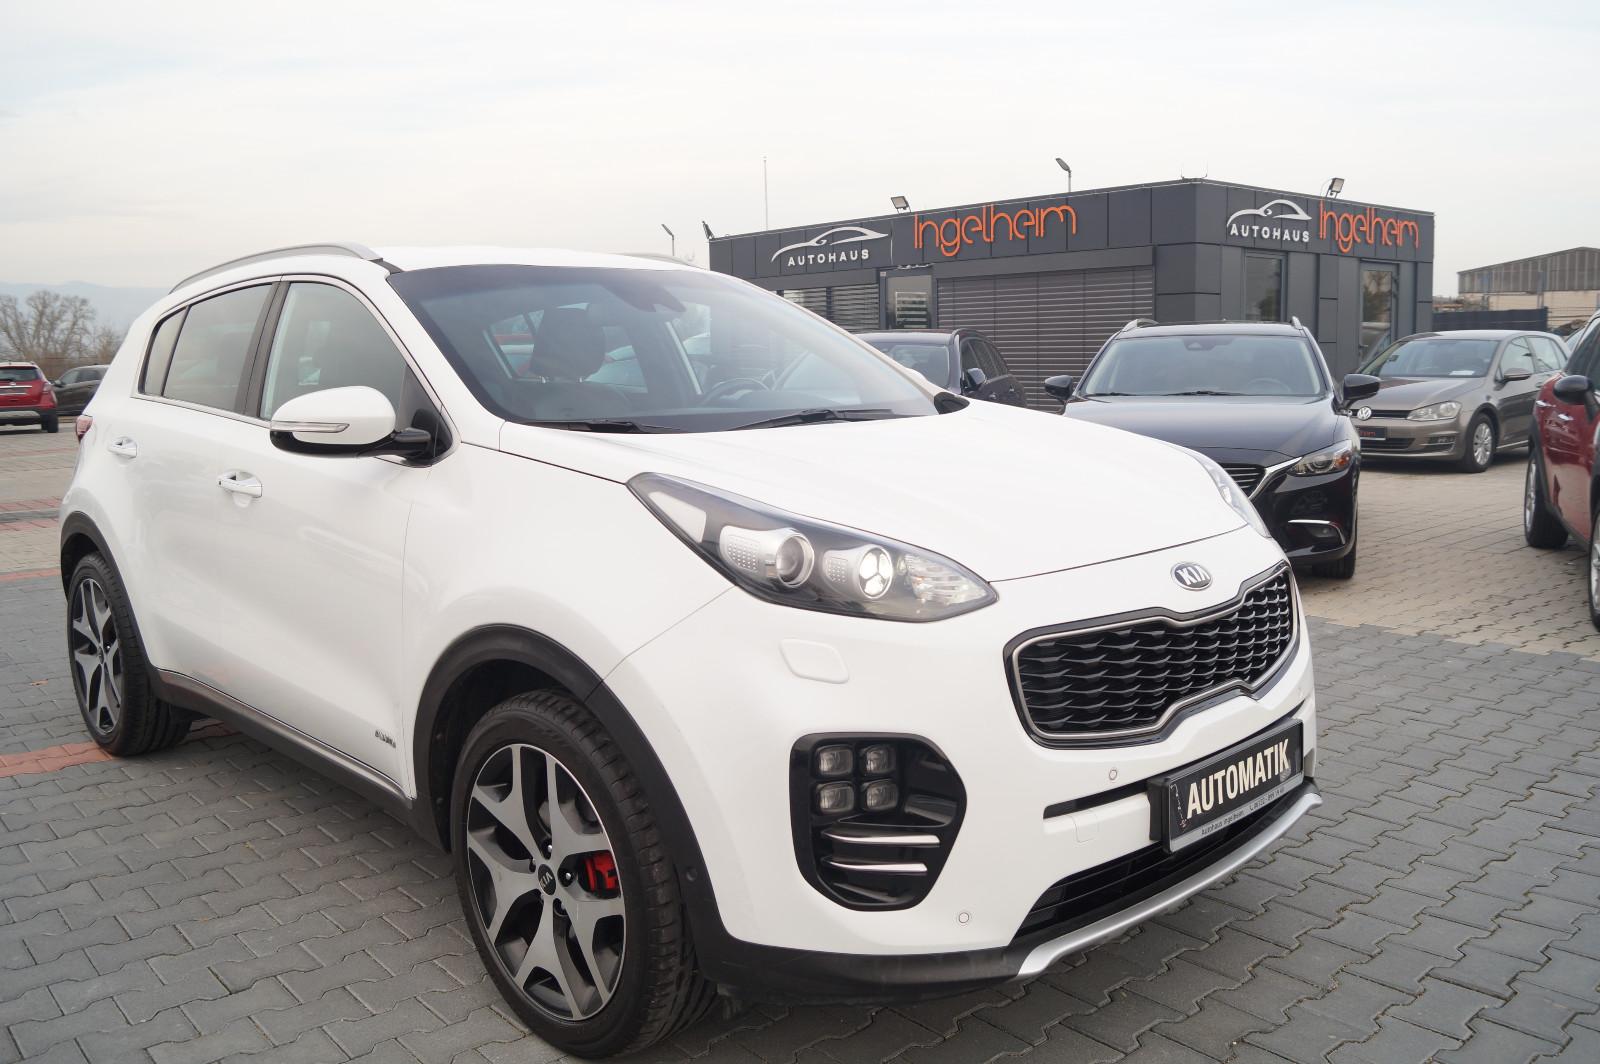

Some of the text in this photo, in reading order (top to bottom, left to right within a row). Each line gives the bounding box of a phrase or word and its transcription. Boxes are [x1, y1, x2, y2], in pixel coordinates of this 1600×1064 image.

[914, 203, 1077, 257] Ingelheim
[1230, 223, 1310, 243] AUTOHAUS
[1319, 199, 1419, 253] Ingelheim
[787, 248, 870, 267] AUTOHAUS
[1176, 565, 1211, 586] KIA
[1187, 738, 1290, 819] AUTOMATIK
